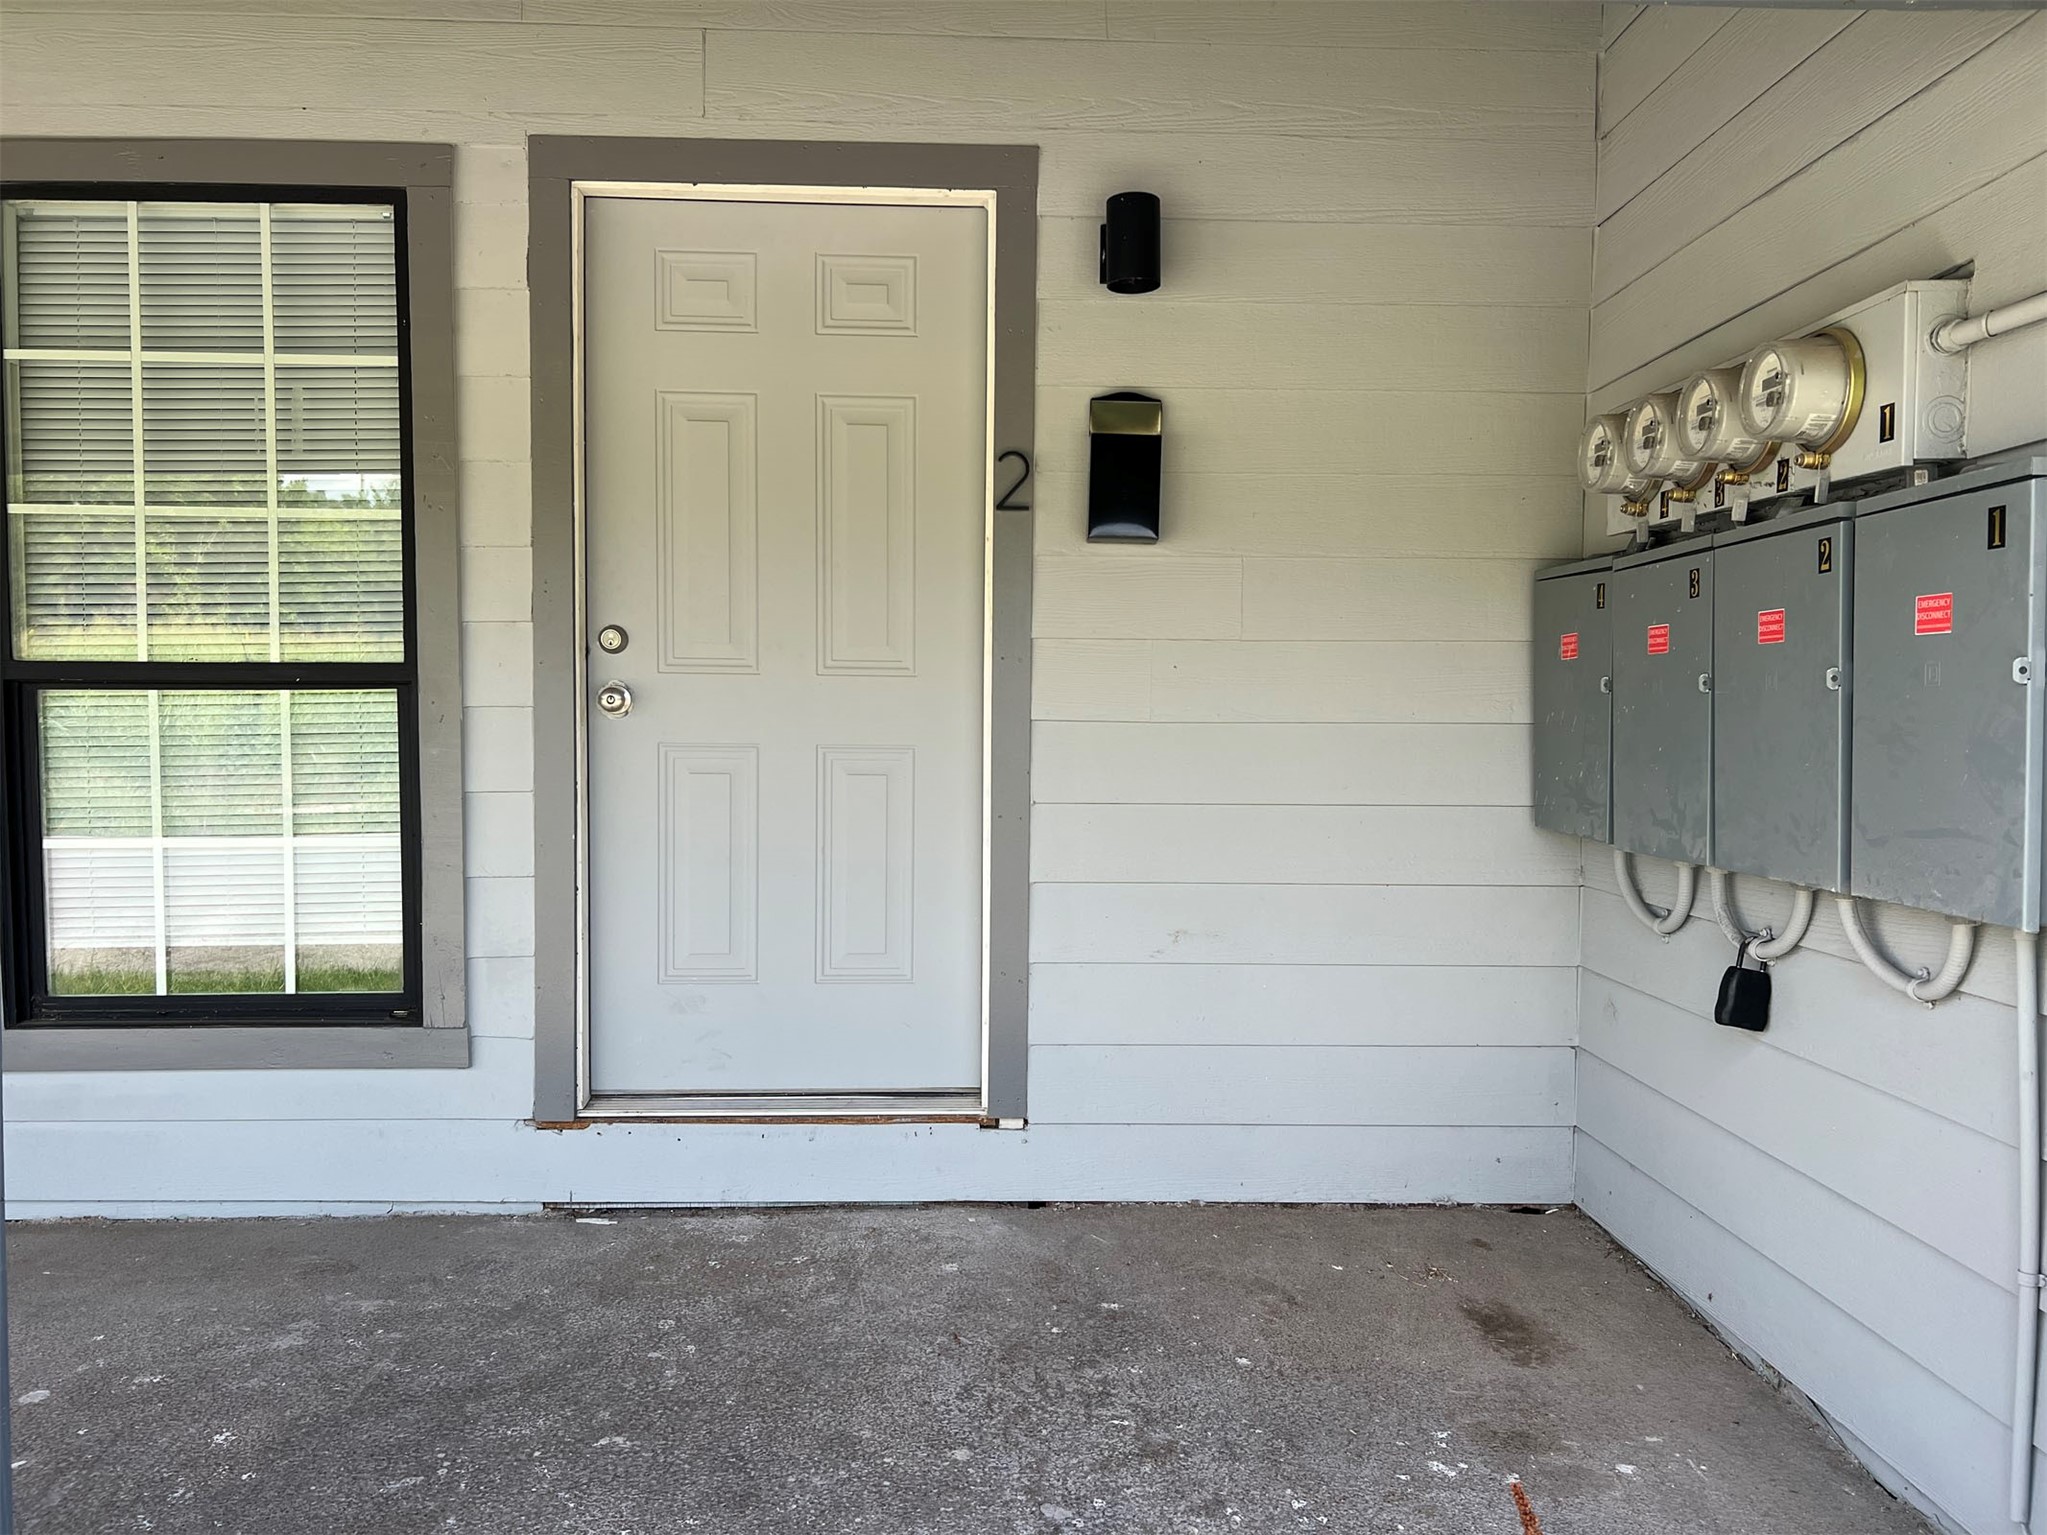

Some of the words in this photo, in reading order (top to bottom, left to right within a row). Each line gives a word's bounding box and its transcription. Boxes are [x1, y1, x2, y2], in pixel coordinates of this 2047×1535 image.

[1883, 405, 1891, 440] 1
[996, 450, 1030, 511] 2
[1778, 461, 1787, 490] 2
[1716, 479, 1723, 505] 3
[1992, 508, 2001, 546] 1
[1820, 540, 1830, 571] 2
[1598, 584, 1604, 607] 4
[1691, 570, 1698, 597] 3
[1917, 610, 1951, 620] DISCONNECT
[1918, 598, 1951, 609] EMERGENCY
[1759, 613, 1783, 622] EMERGENCY
